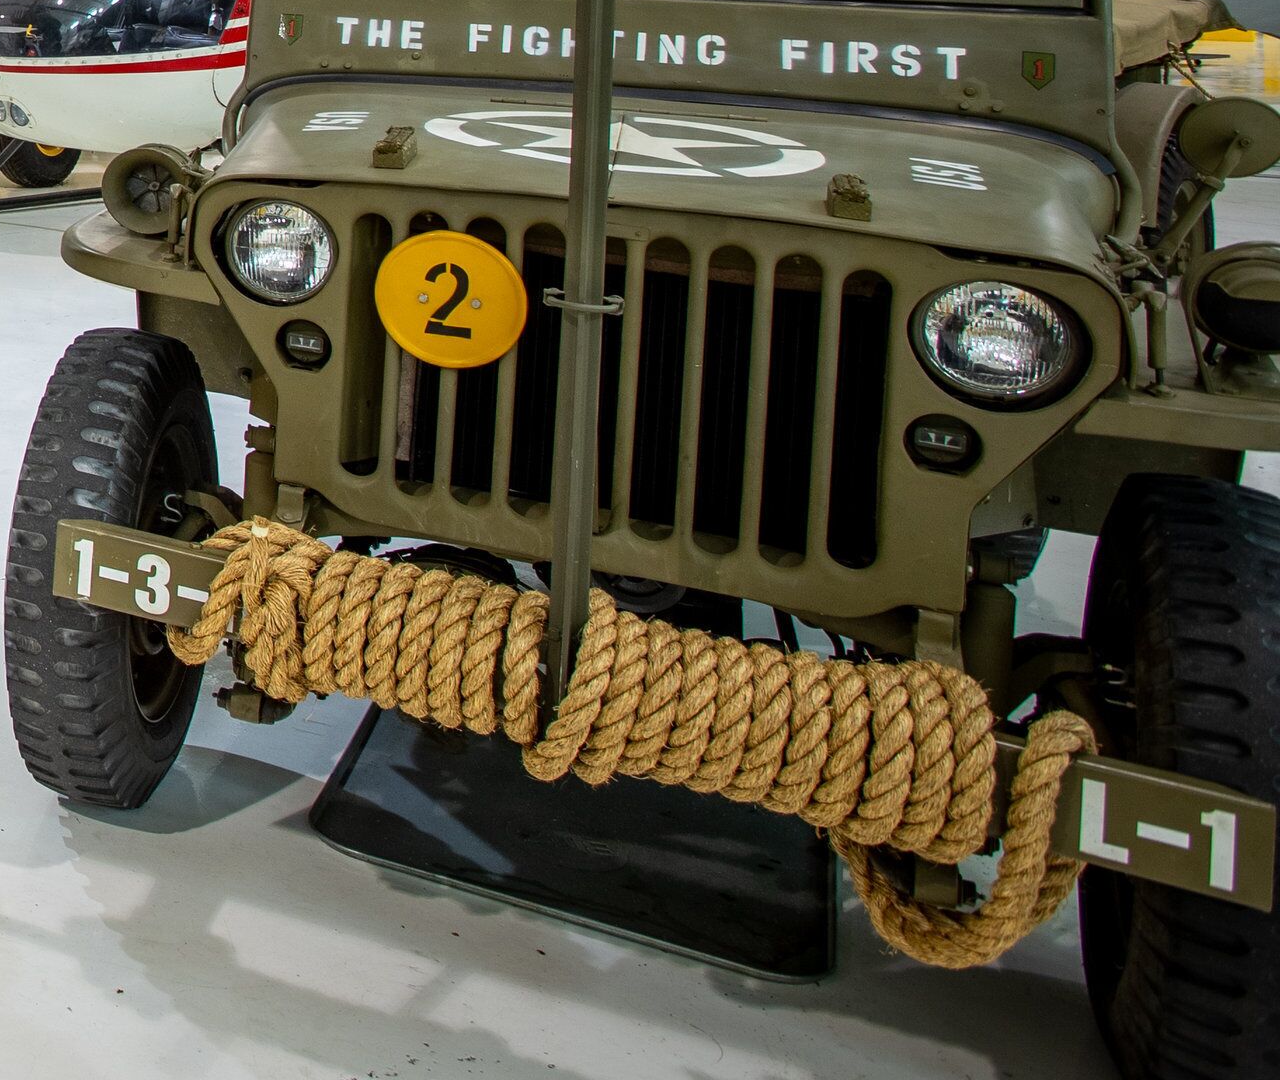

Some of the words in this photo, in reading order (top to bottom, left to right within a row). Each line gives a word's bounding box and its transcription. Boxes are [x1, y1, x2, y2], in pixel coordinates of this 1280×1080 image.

[337, 16, 425, 51] THE
[780, 38, 968, 81] FIRST
[301, 110, 372, 133] USA
[907, 156, 989, 192] USA
[424, 262, 472, 340] 2
[1078, 777, 1237, 892] L-1
